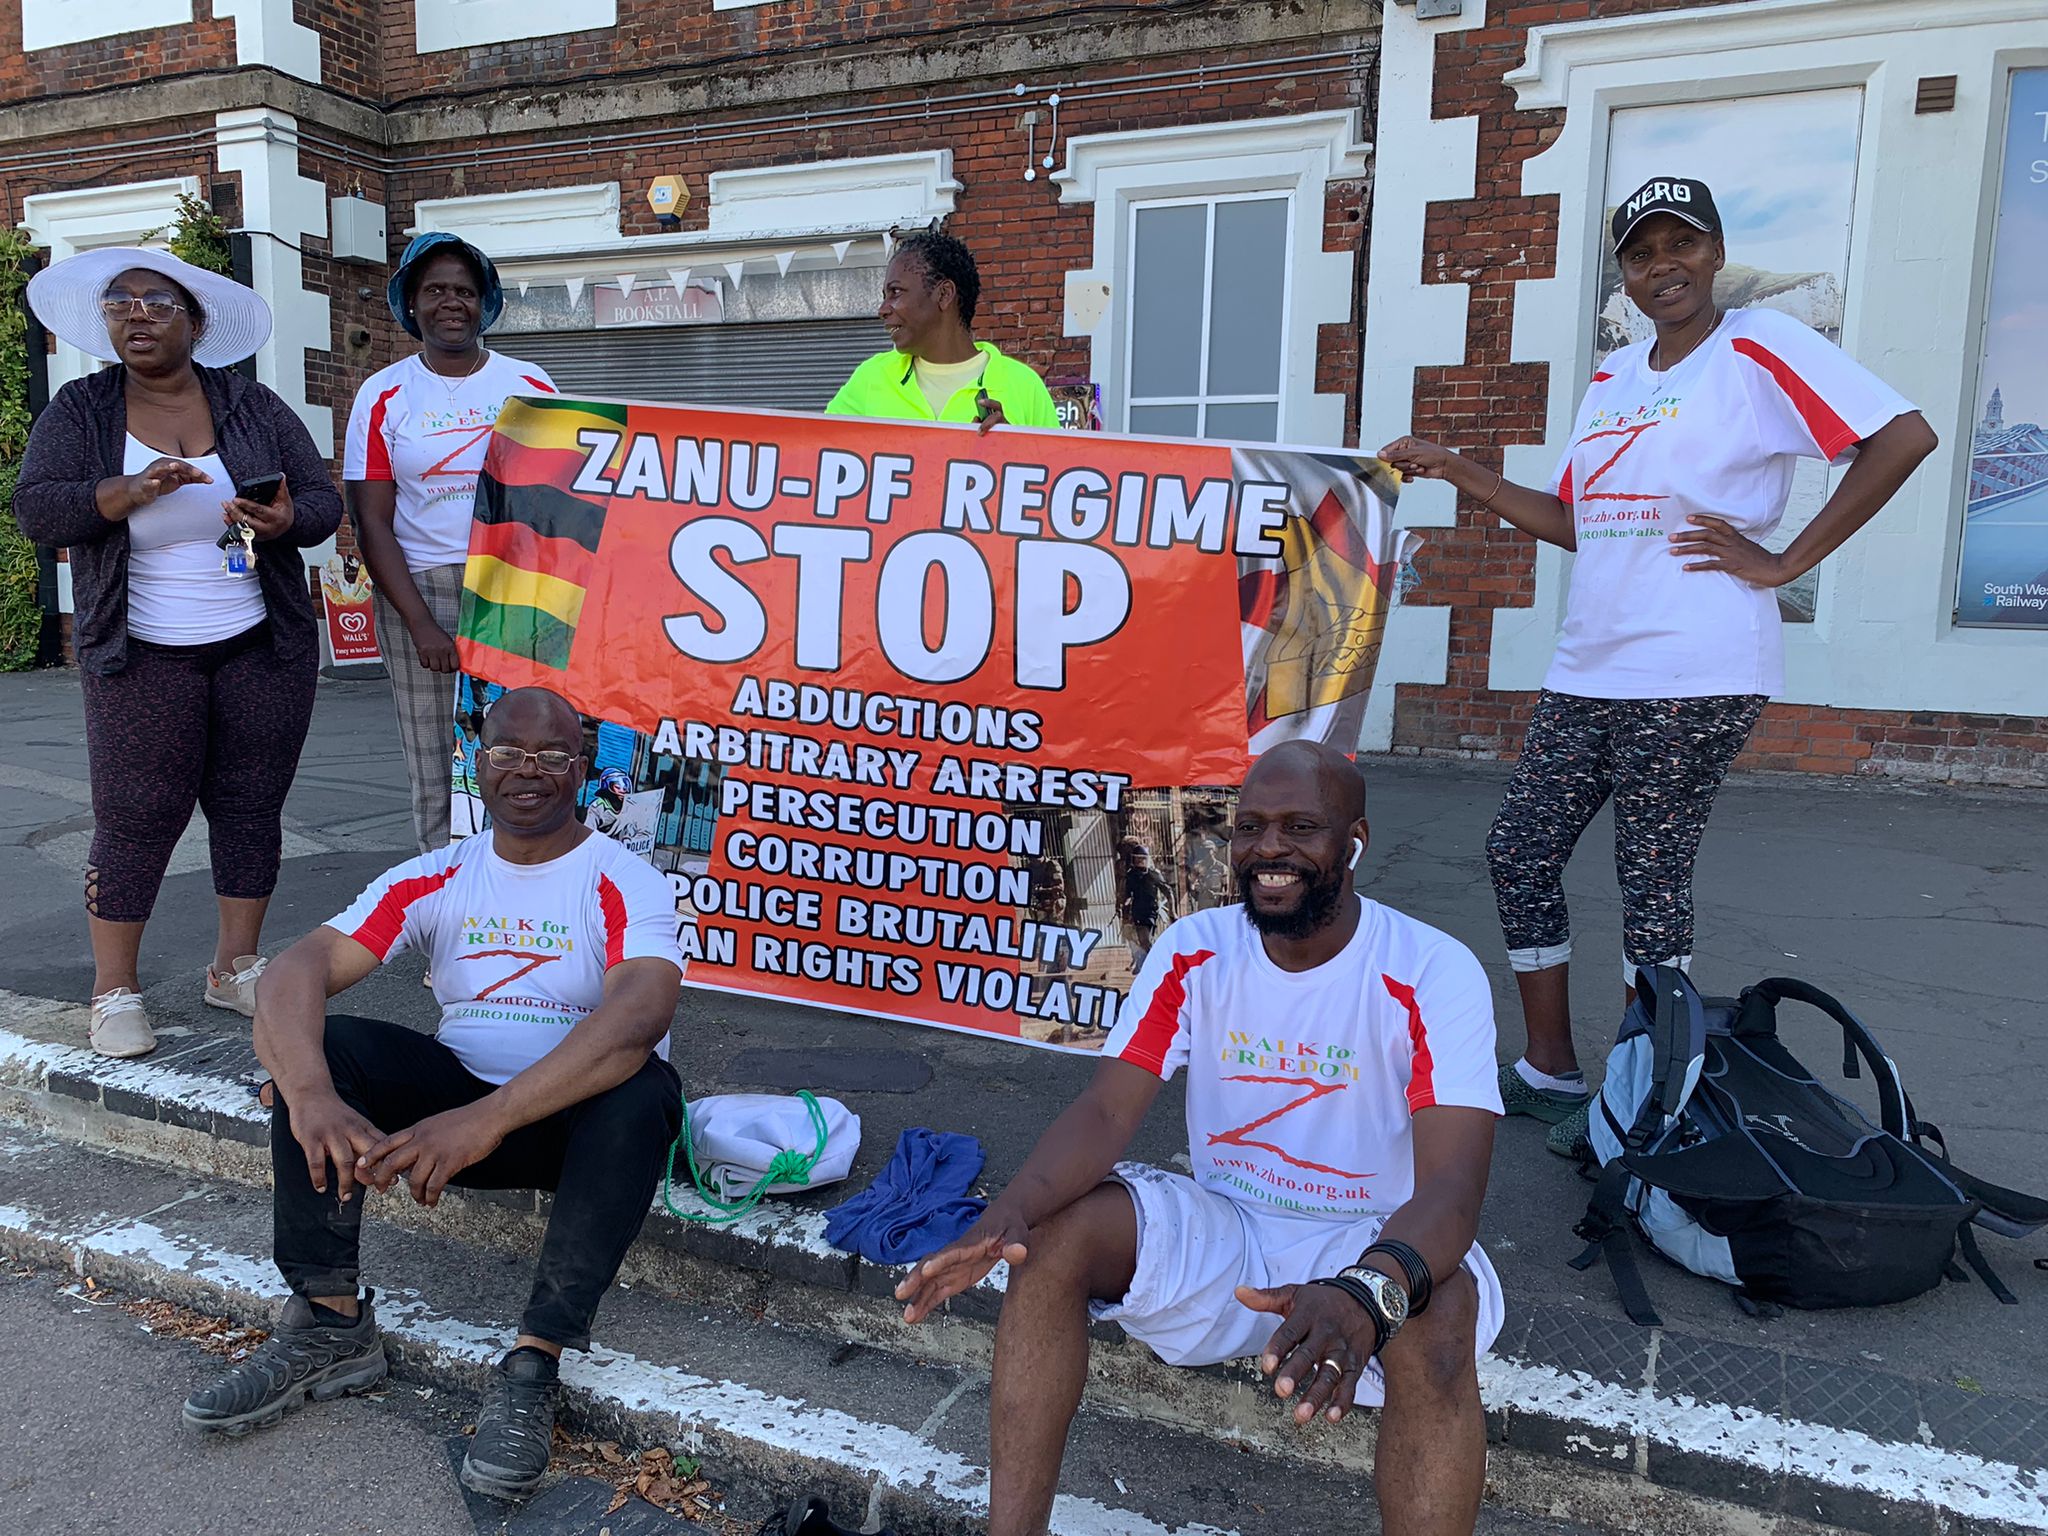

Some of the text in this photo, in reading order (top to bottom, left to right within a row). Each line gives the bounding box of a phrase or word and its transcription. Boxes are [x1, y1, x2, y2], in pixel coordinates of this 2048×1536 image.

[2033, 111, 2048, 143] T
[2029, 159, 2048, 183] S
[1626, 181, 1691, 220] NERO
[643, 287, 670, 303] A.P.
[614, 303, 703, 323] BOOKSTALL
[1055, 401, 1079, 421] sh
[570, 428, 1292, 558] ZANU-PF REGIME
[661, 515, 1133, 692] STOP
[1983, 582, 2023, 595] South
[1996, 595, 2047, 610] Railway
[731, 677, 1041, 751] ABDUCTIONS
[650, 719, 1130, 812] ARBITRARY ARREST
[720, 778, 1044, 857] PERSECUTION
[725, 831, 1031, 906] CORRUPTION
[463, 916, 570, 935] WALK for
[665, 871, 1100, 968] POLICE BRUTALITY
[458, 931, 573, 951] FREEDOM
[753, 935, 921, 994] RIGHTS
[936, 963, 1124, 1028] VIOLATI
[454, 1007, 581, 1027] @ZHRO100kmW
[1228, 1030, 1319, 1056] WALK
[1221, 1048, 1360, 1081] FREEDOM
[1212, 1157, 1372, 1201] www.zhro.org.uk
